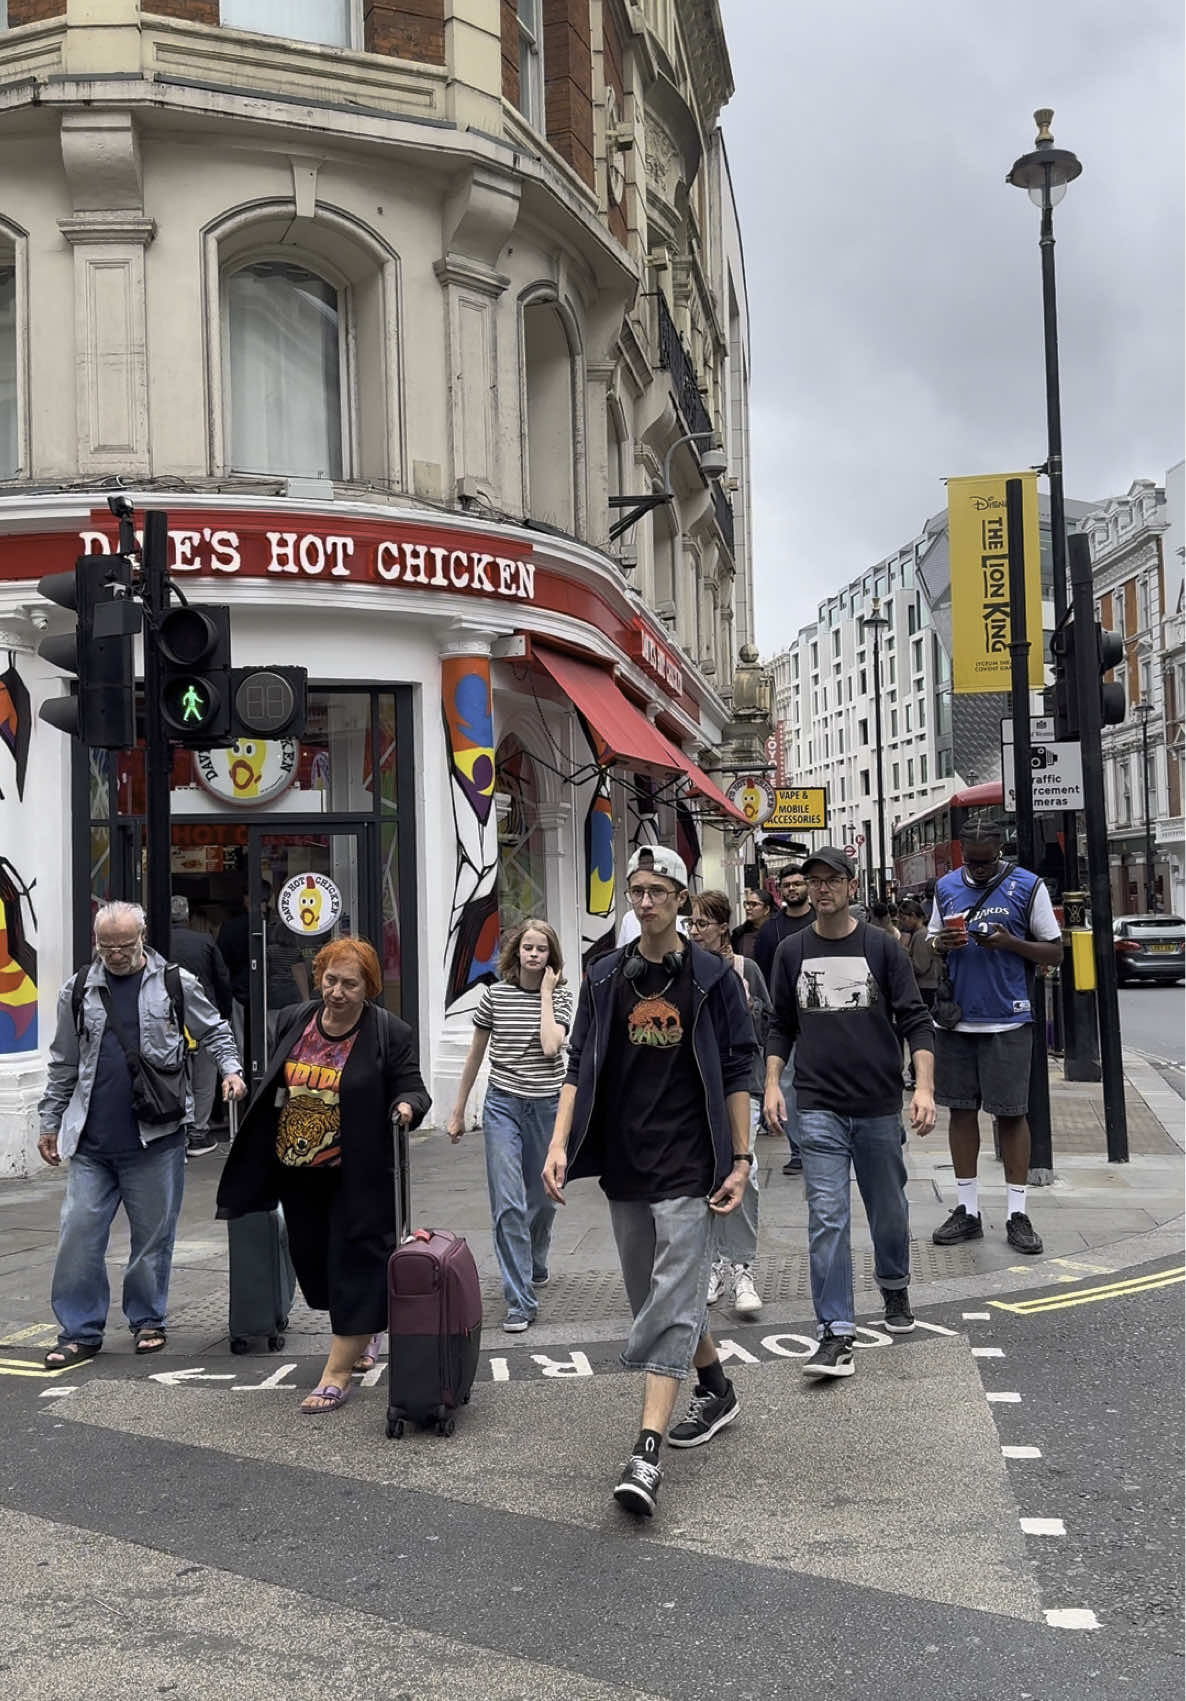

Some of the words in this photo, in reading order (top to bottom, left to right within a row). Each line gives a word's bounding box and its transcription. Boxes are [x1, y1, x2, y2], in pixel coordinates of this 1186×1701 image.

[987, 516, 1003, 550] THE
[79, 528, 241, 573] DE'S
[266, 531, 354, 576] HOT
[377, 541, 536, 599] CHICKEN
[981, 553, 1008, 598] LION
[982, 602, 1009, 653] KING
[779, 791, 799, 800] VAPE
[801, 791, 808, 800] &
[1032, 774, 1062, 784] raffic
[779, 805, 809, 813] MOBILE
[1034, 798, 1068, 807] meras
[281, 891, 294, 922] DAVE'S
[288, 877, 305, 892] HOT
[315, 877, 340, 914] CHICKEN
